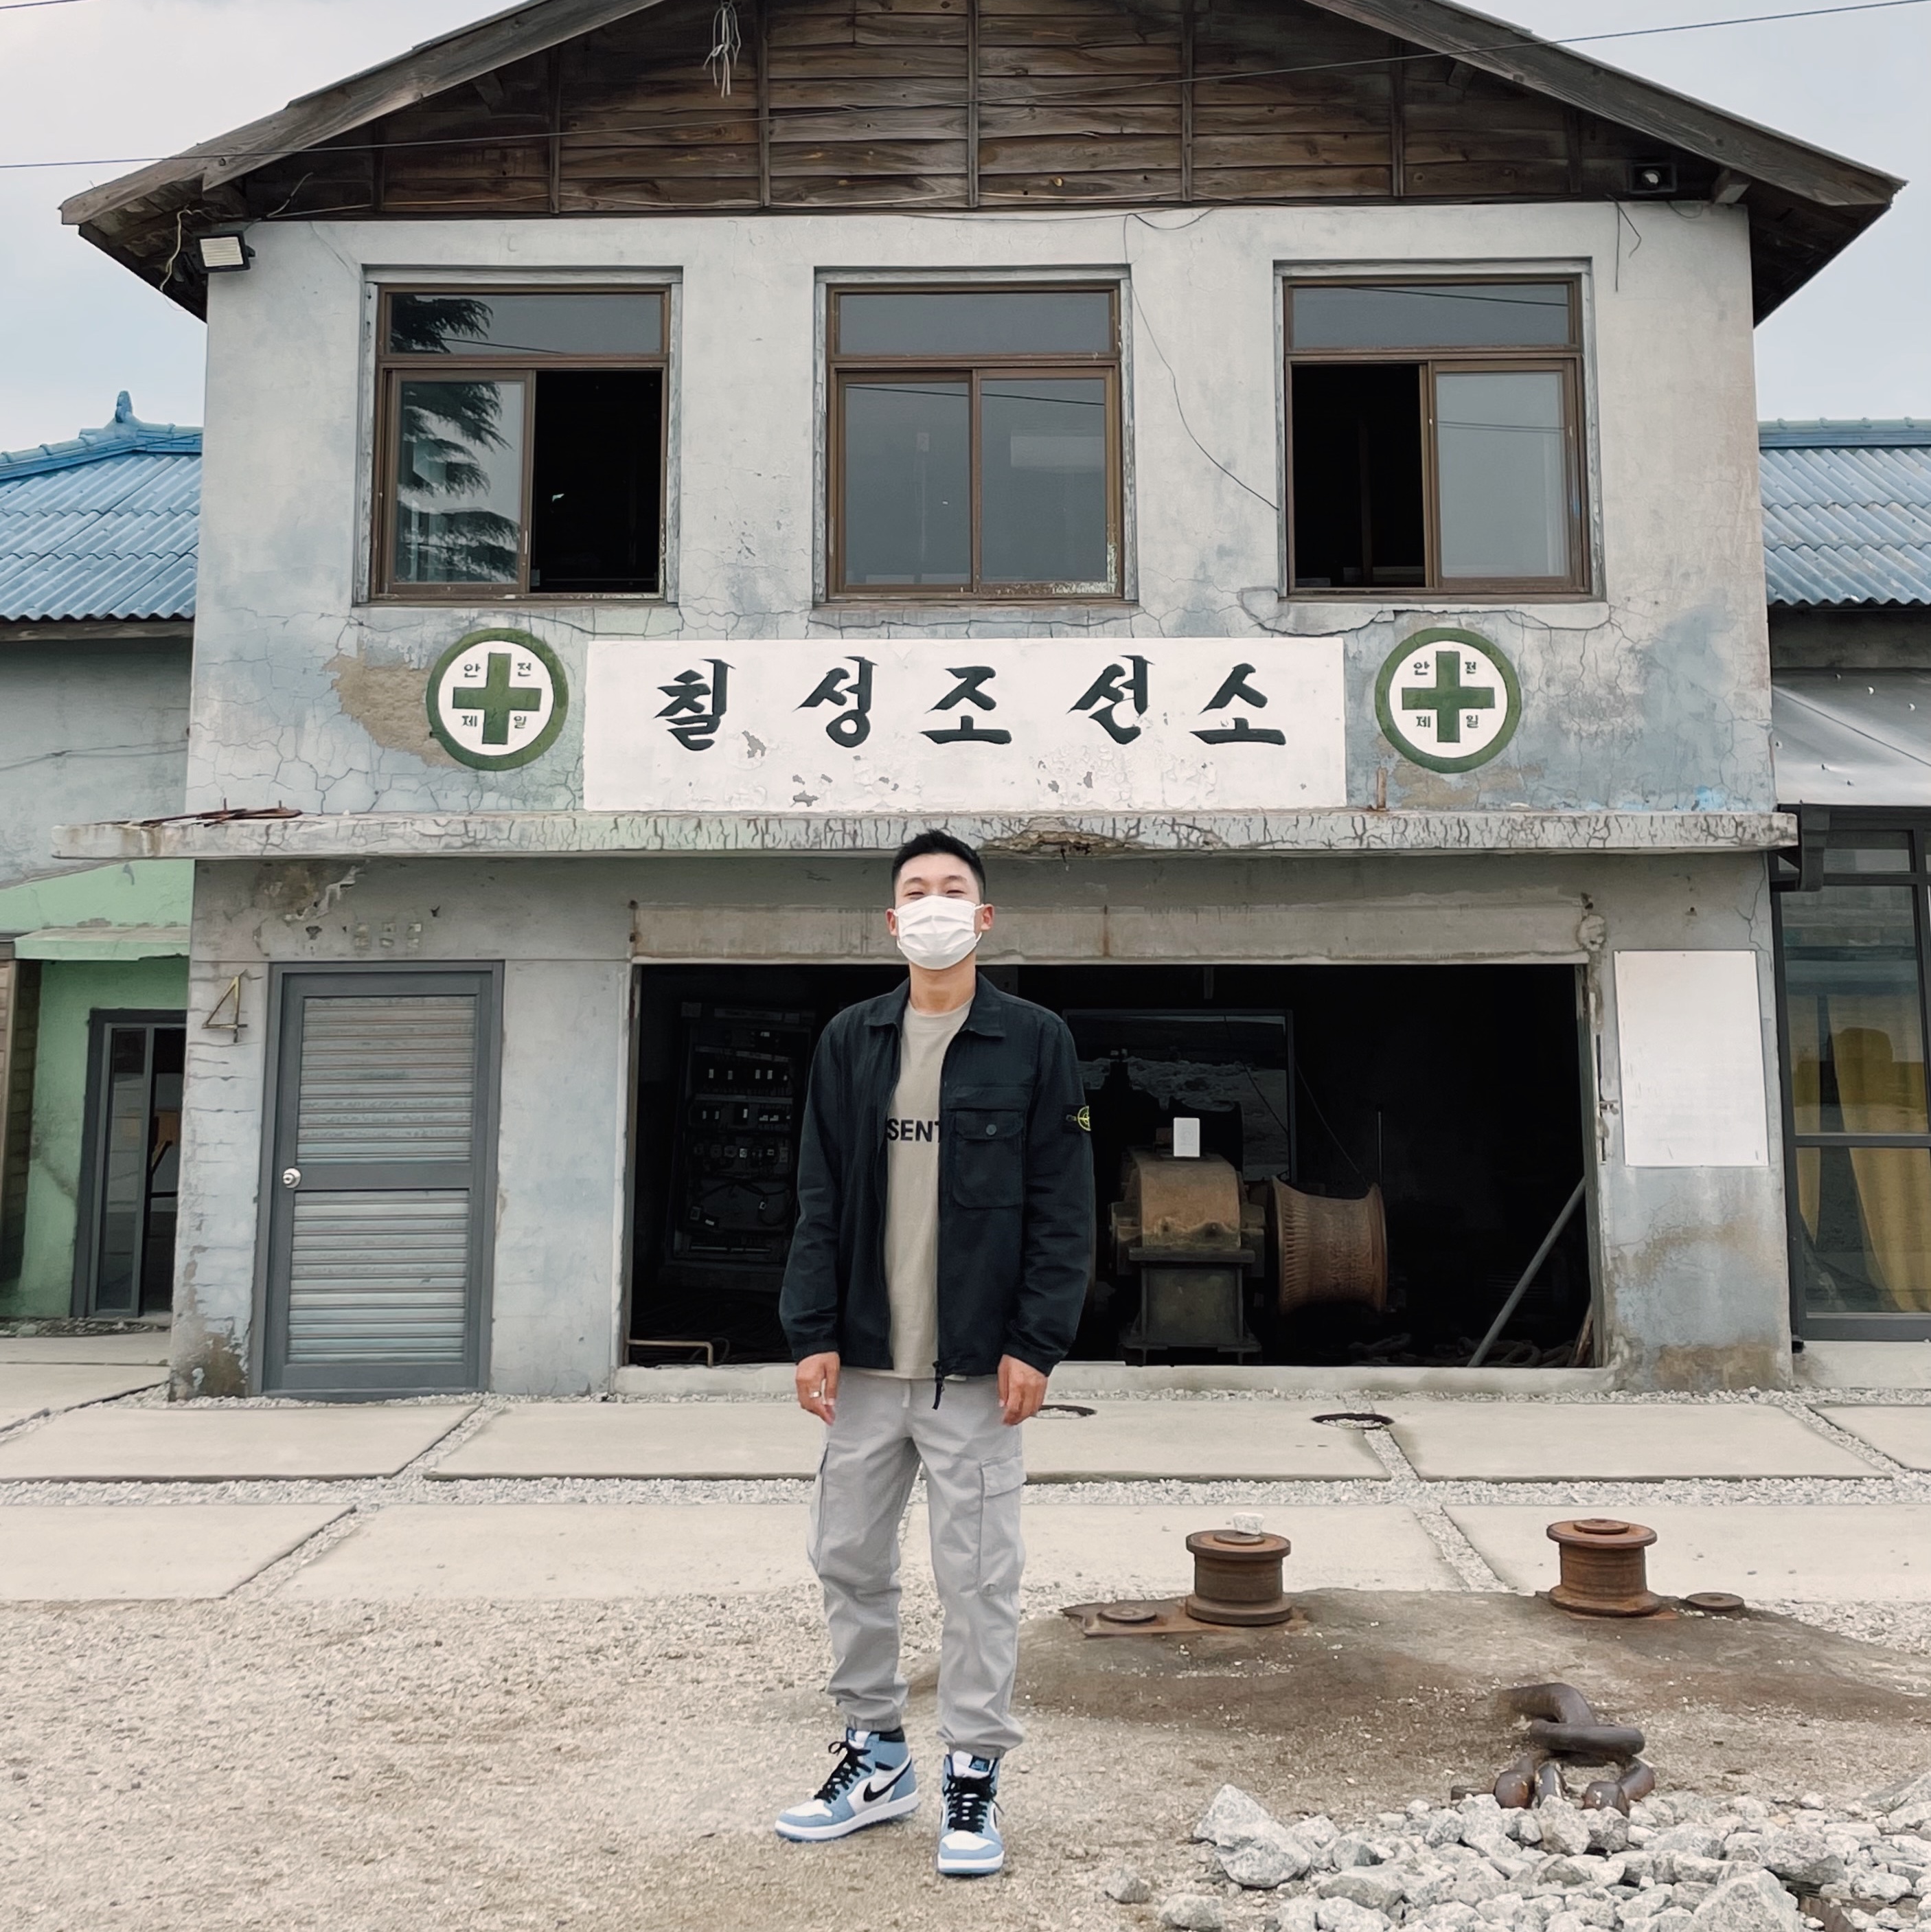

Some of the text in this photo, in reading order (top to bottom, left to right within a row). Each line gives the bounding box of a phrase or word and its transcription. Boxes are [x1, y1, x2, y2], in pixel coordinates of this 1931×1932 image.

[464, 662, 532, 678] 안전
[654, 655, 1286, 751] 칠성조선소
[461, 715, 527, 729] 제일
[1416, 715, 1478, 729] 제일
[202, 975, 248, 1043] 4
